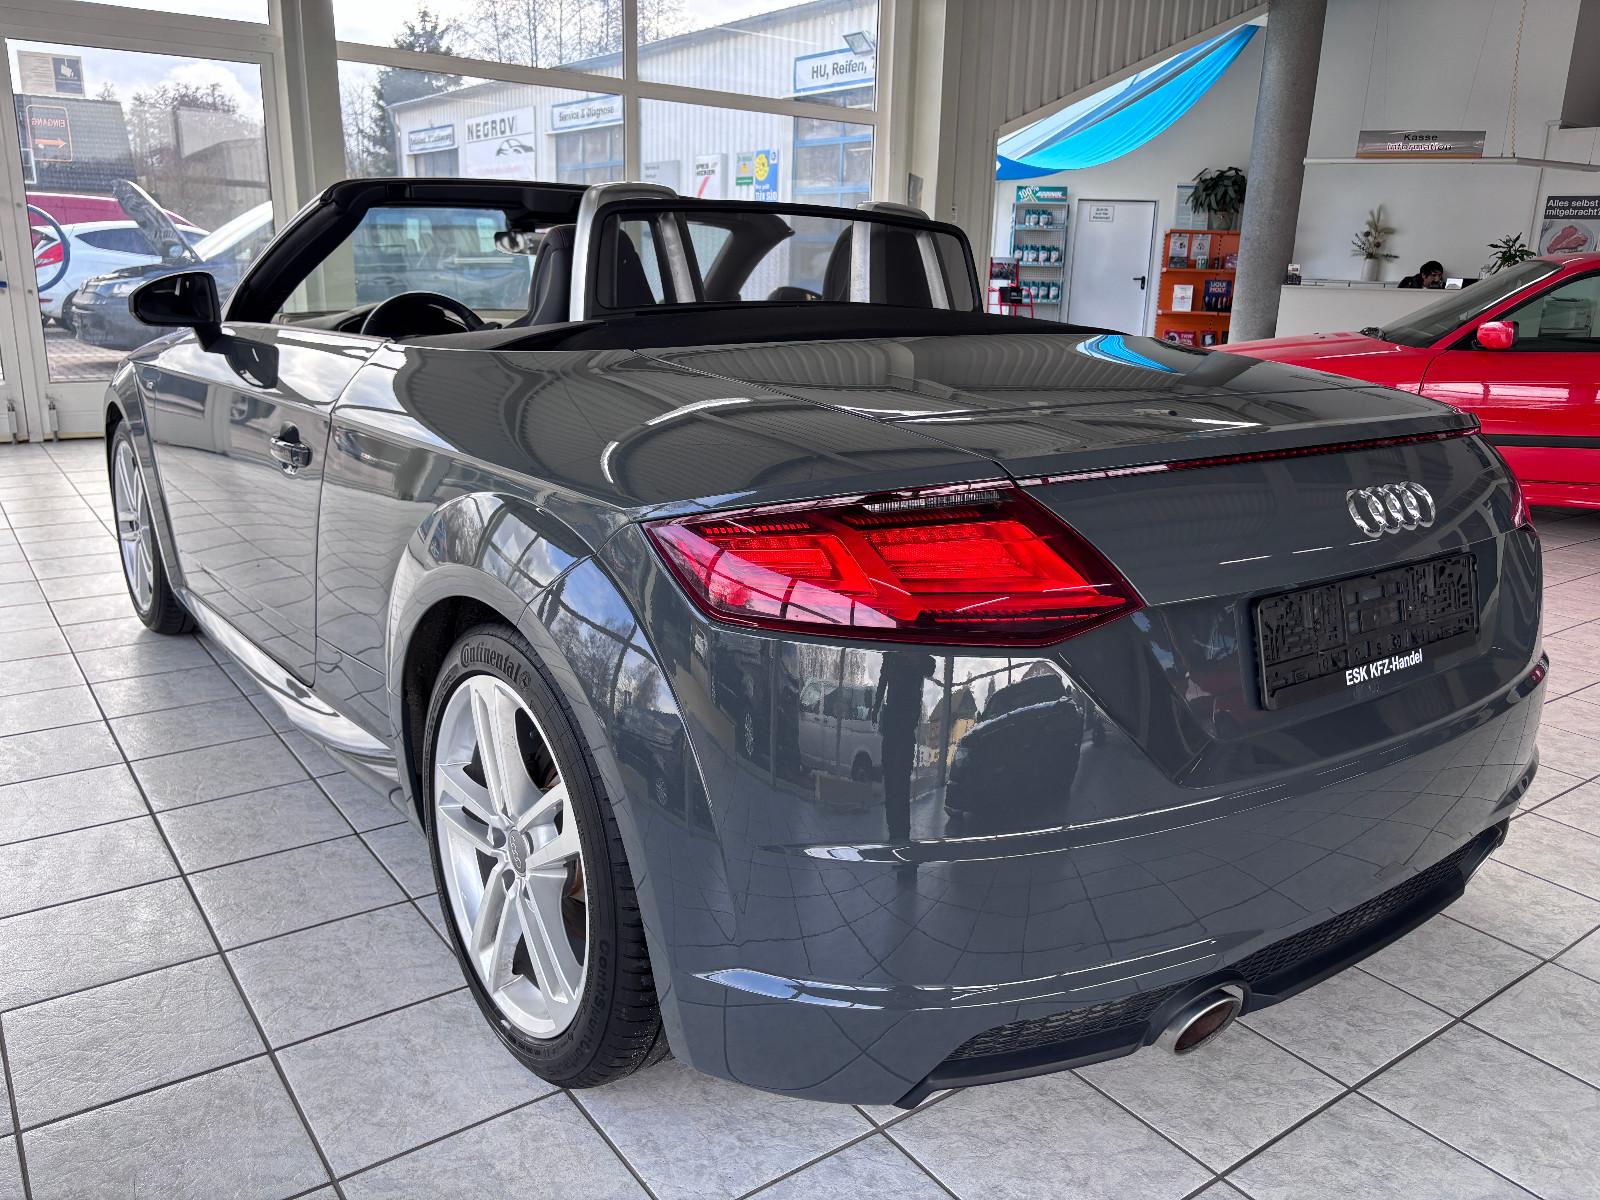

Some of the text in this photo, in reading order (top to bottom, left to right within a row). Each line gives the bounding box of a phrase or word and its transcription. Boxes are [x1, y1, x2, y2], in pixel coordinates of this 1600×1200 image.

[811, 64, 829, 80] HU,
[832, 59, 867, 74] Reifen,
[467, 116, 514, 141] NEGROV
[1403, 133, 1439, 141] Kasse
[1547, 199, 1599, 207] Alles selbst
[460, 642, 522, 686] Continental
[1345, 648, 1423, 686] ESK KFZ-Handel
